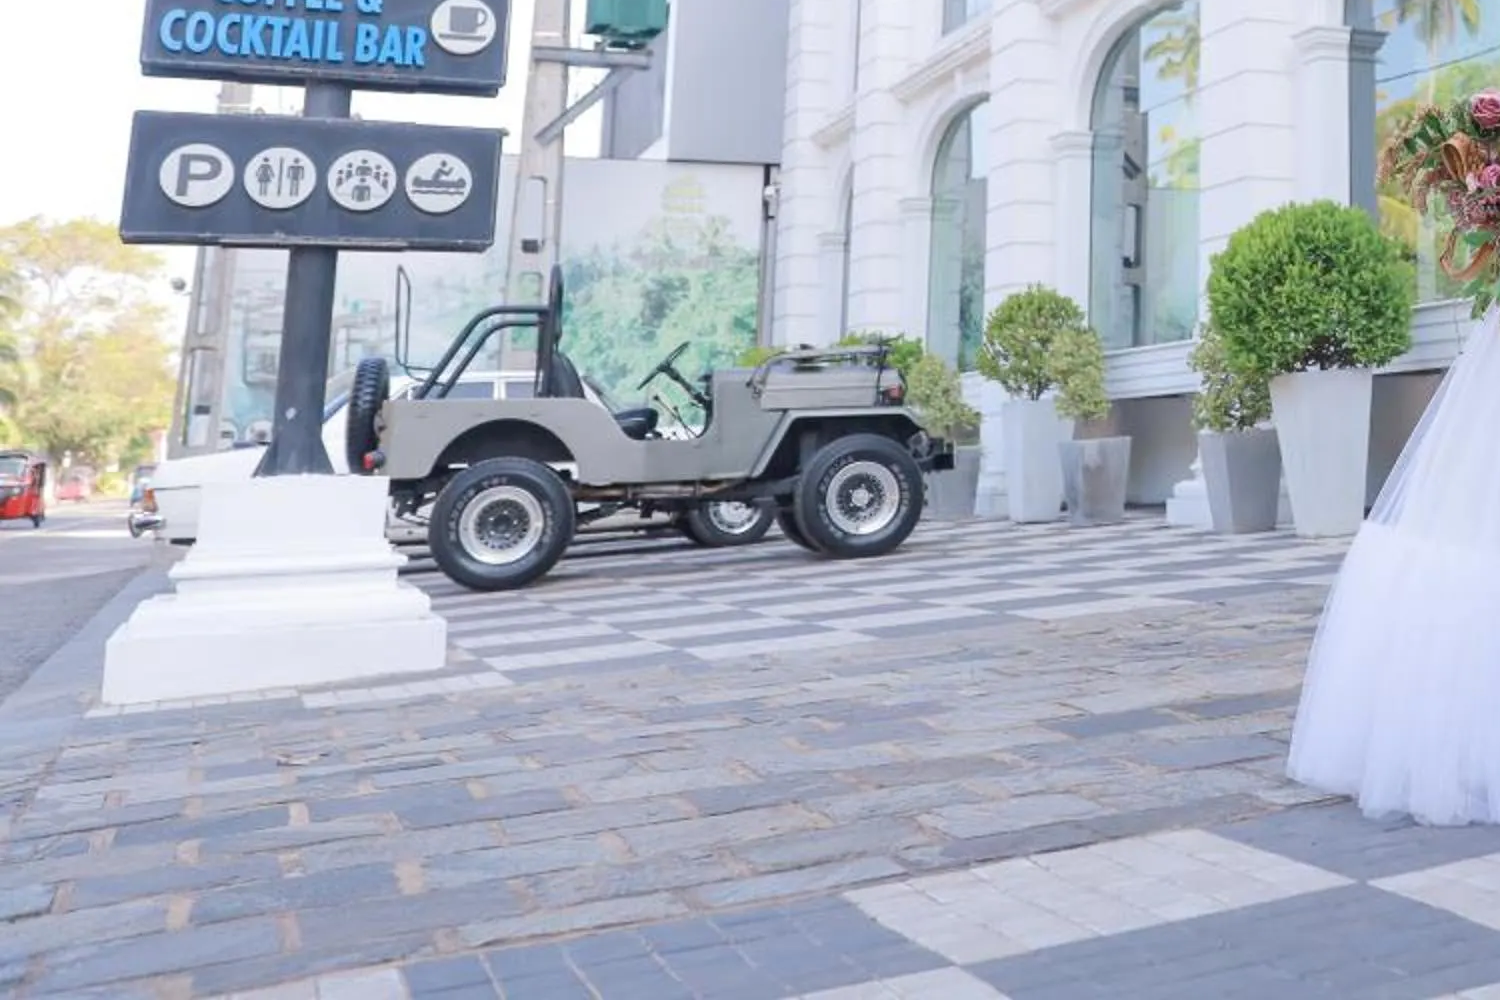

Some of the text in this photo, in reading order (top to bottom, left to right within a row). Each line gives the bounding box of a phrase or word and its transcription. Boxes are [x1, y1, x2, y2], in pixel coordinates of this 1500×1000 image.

[159, 9, 427, 67] COCKTAIL BAR
[175, 153, 222, 196] P
